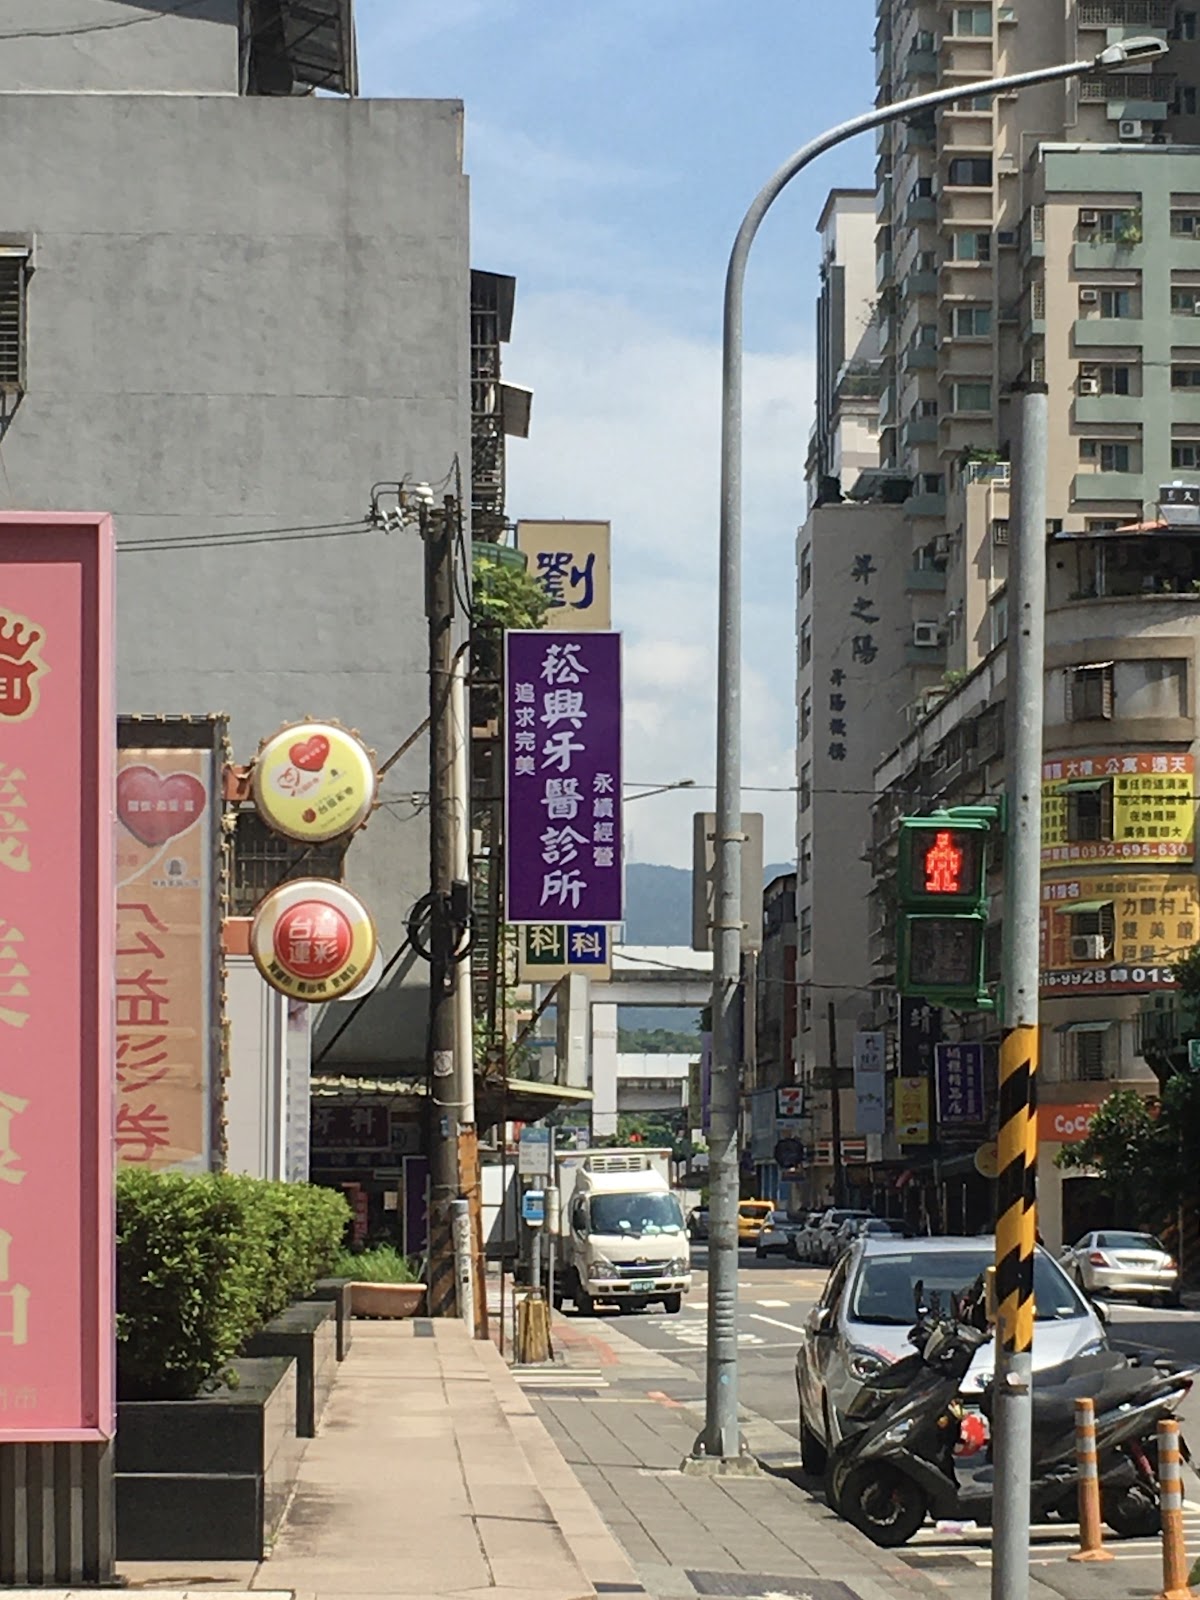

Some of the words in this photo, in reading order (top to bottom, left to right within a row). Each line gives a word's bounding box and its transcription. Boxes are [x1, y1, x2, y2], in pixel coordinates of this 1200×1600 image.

[535, 552, 595, 609] 劉
[514, 683, 536, 777] 追求完美
[593, 773, 614, 867] 永續經營
[530, 925, 560, 957] 科
[572, 931, 602, 958] 科
